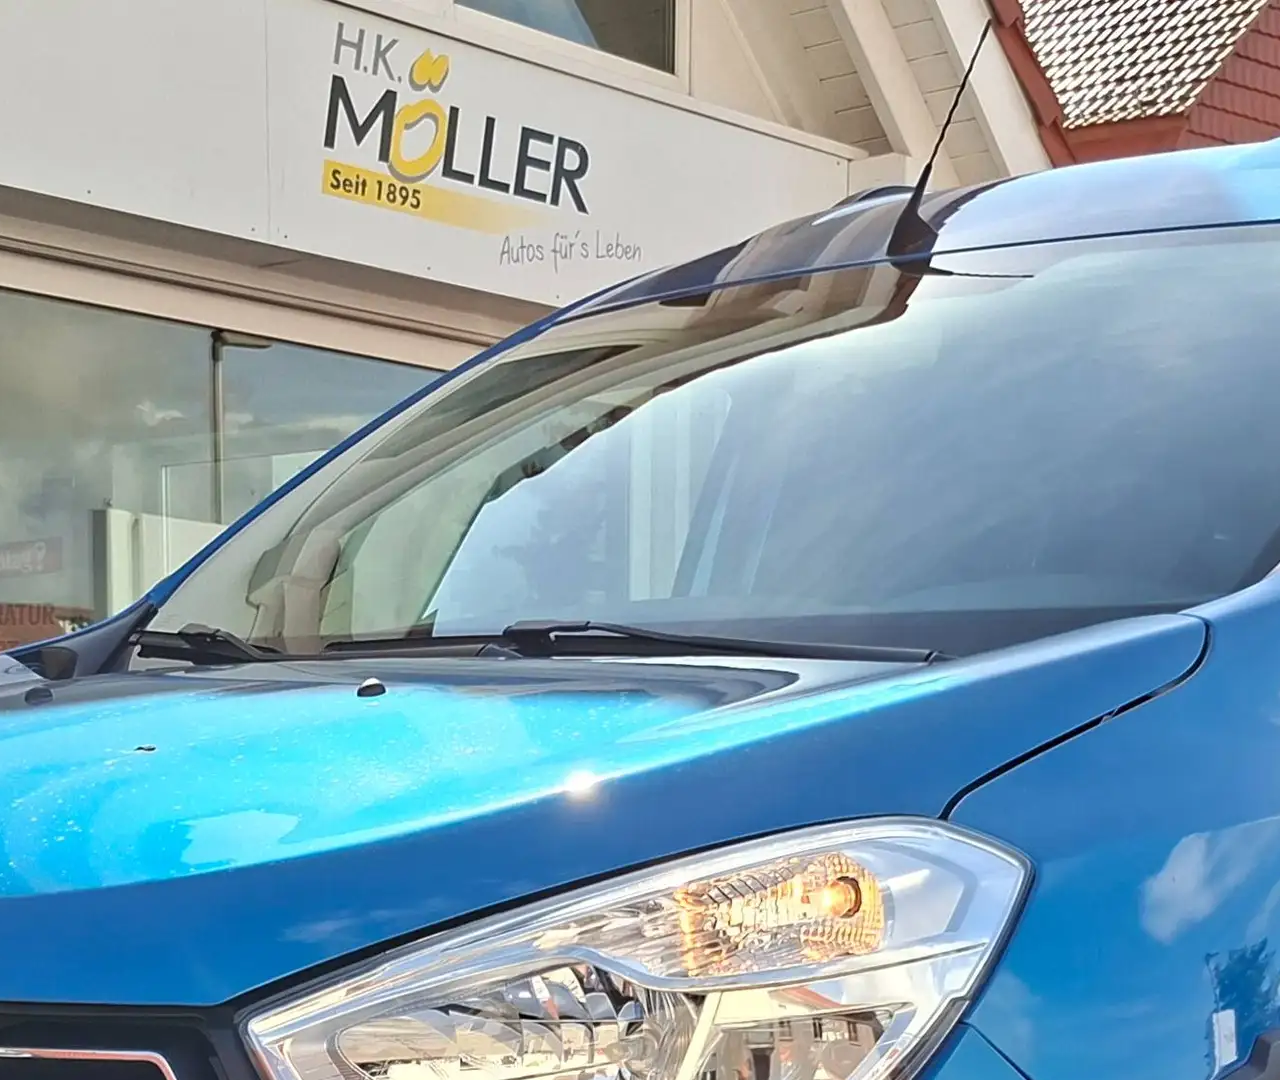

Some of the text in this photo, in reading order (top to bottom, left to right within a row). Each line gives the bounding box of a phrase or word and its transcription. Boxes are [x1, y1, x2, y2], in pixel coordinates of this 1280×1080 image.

[333, 22, 402, 83] H.K.
[324, 48, 589, 215] MÖLLER
[330, 170, 421, 209] Seit 1895
[500, 235, 544, 266] Autos
[595, 230, 642, 262] Leben
